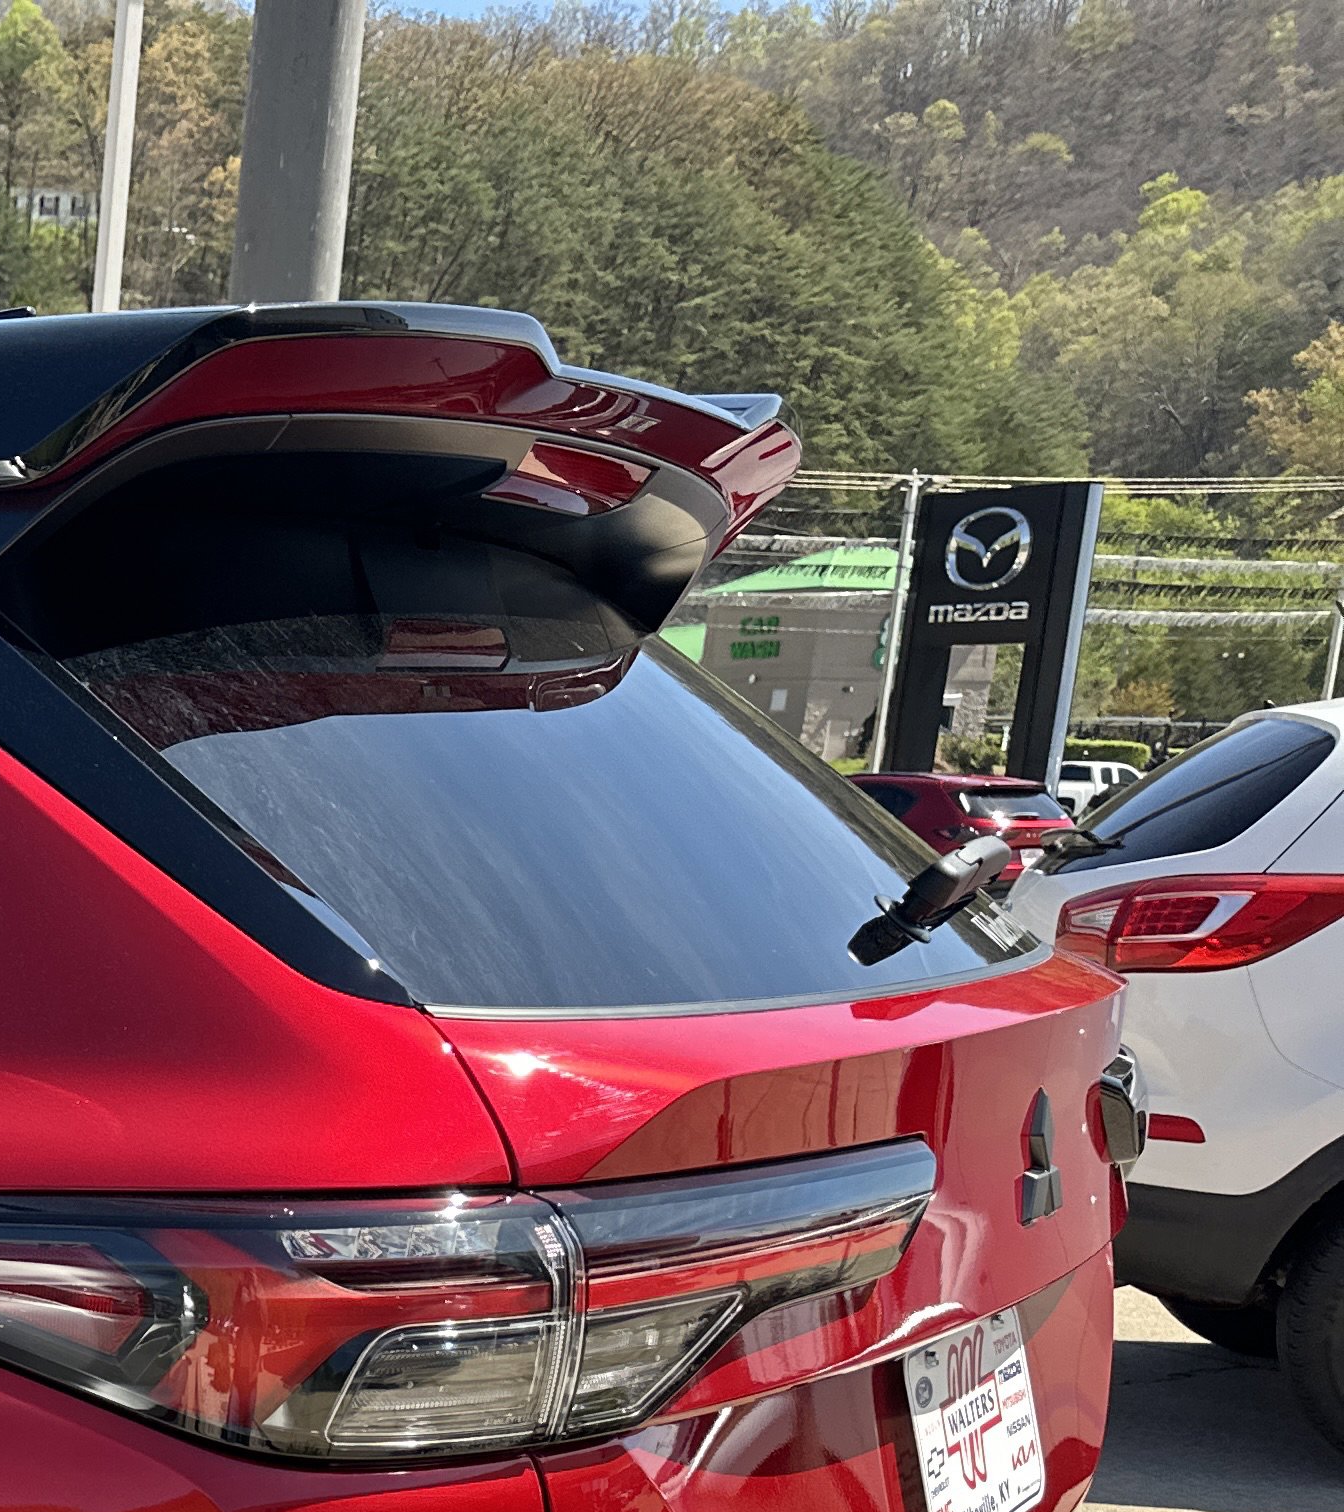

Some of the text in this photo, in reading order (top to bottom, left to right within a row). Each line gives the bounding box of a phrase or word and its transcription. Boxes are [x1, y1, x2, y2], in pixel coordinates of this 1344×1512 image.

[929, 601, 1029, 624] mazda
[740, 615, 780, 635] CAR
[731, 640, 780, 660] WASH
[993, 1331, 1018, 1355] TOYOTA
[948, 1388, 995, 1435] WALTERS
[999, 1478, 1010, 1504] KY
